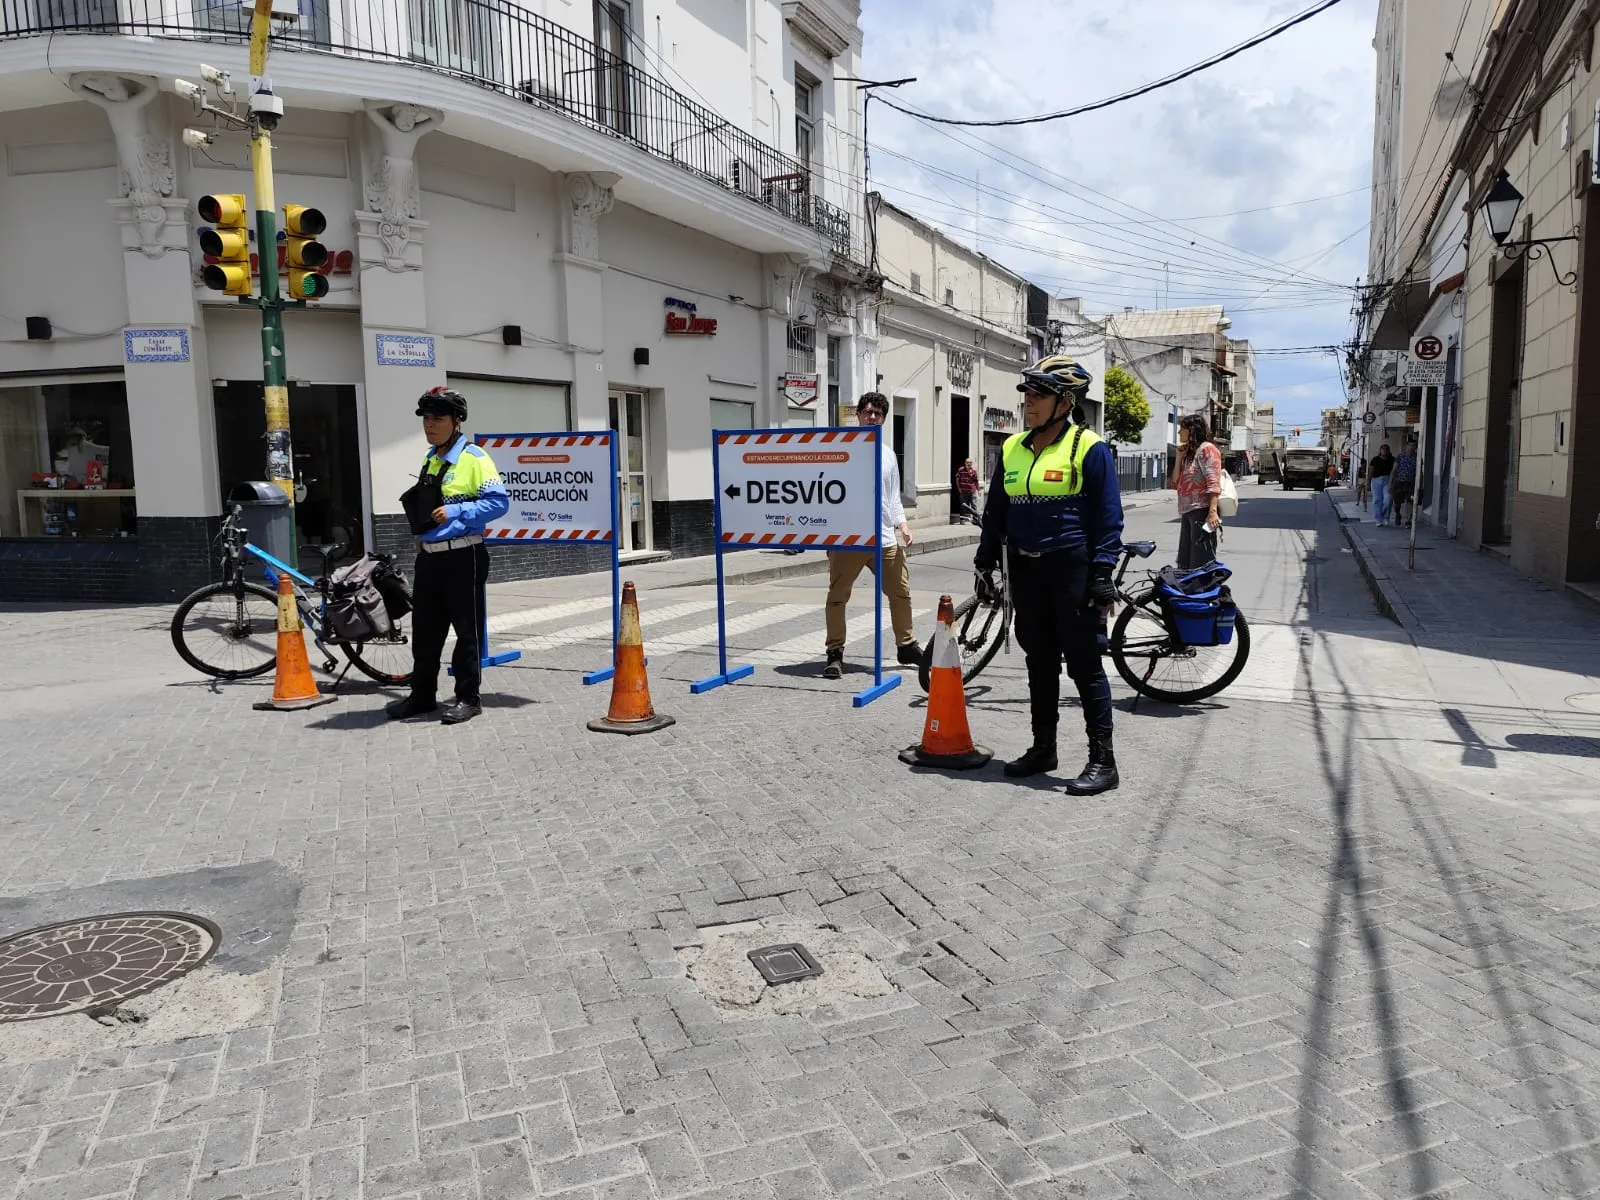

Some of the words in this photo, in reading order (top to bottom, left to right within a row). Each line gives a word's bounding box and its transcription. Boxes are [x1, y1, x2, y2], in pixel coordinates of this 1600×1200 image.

[666, 311, 687, 331] San
[688, 313, 718, 336] Jorge
[772, 454, 814, 462] RECUPERANDO
[499, 471, 562, 484] CIRCULAR
[564, 471, 593, 484] CON
[505, 485, 588, 502] PRECAUCIÓN
[747, 472, 846, 505] DESVÍO
